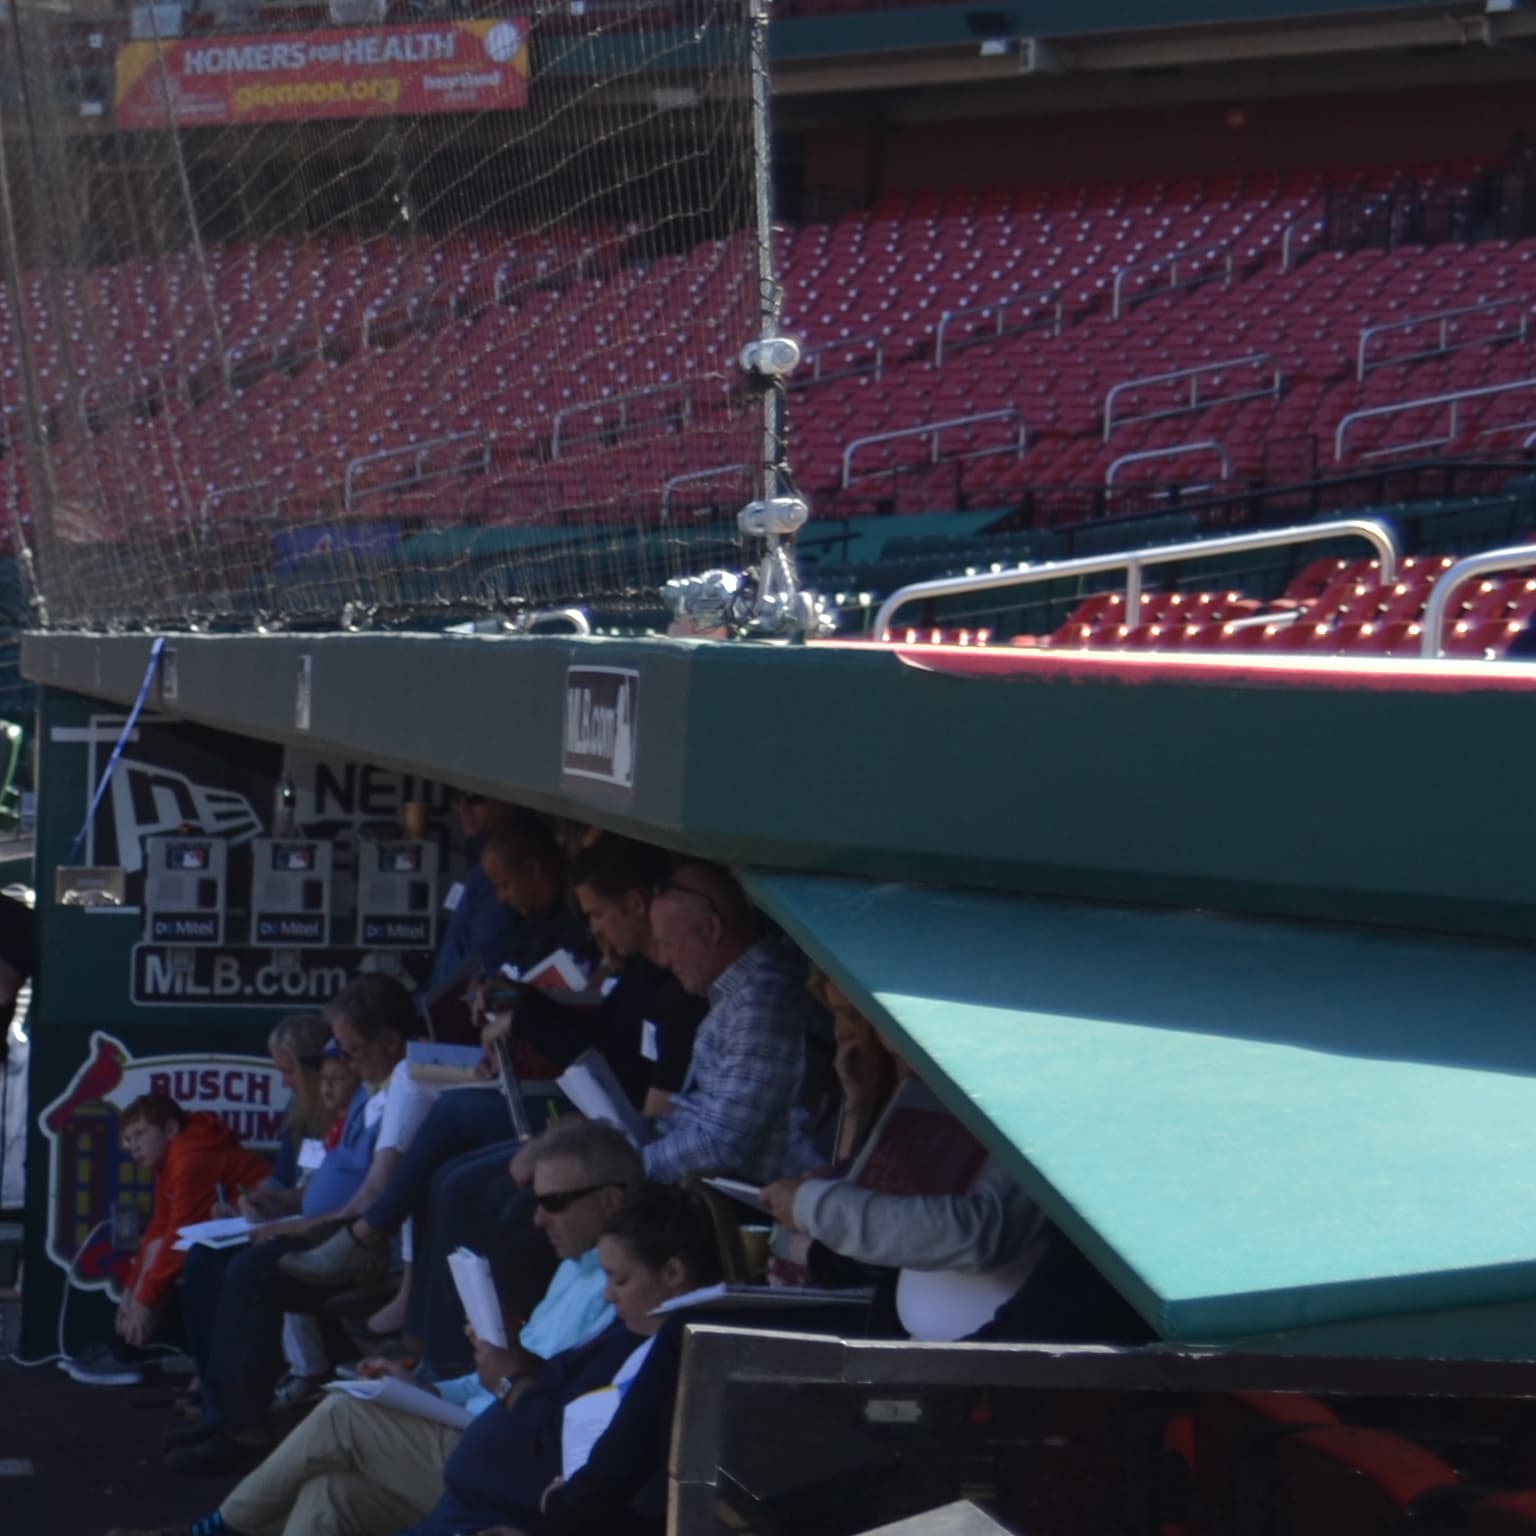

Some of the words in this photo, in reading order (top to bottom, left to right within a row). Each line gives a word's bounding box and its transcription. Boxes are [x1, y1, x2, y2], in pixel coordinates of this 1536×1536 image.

[182, 42, 307, 75] HOMERS
[343, 32, 456, 66] HEALTH
[230, 78, 401, 112] glennon.org
[143, 954, 347, 995] MLB.com
[149, 1069, 271, 1107] BUSCH
